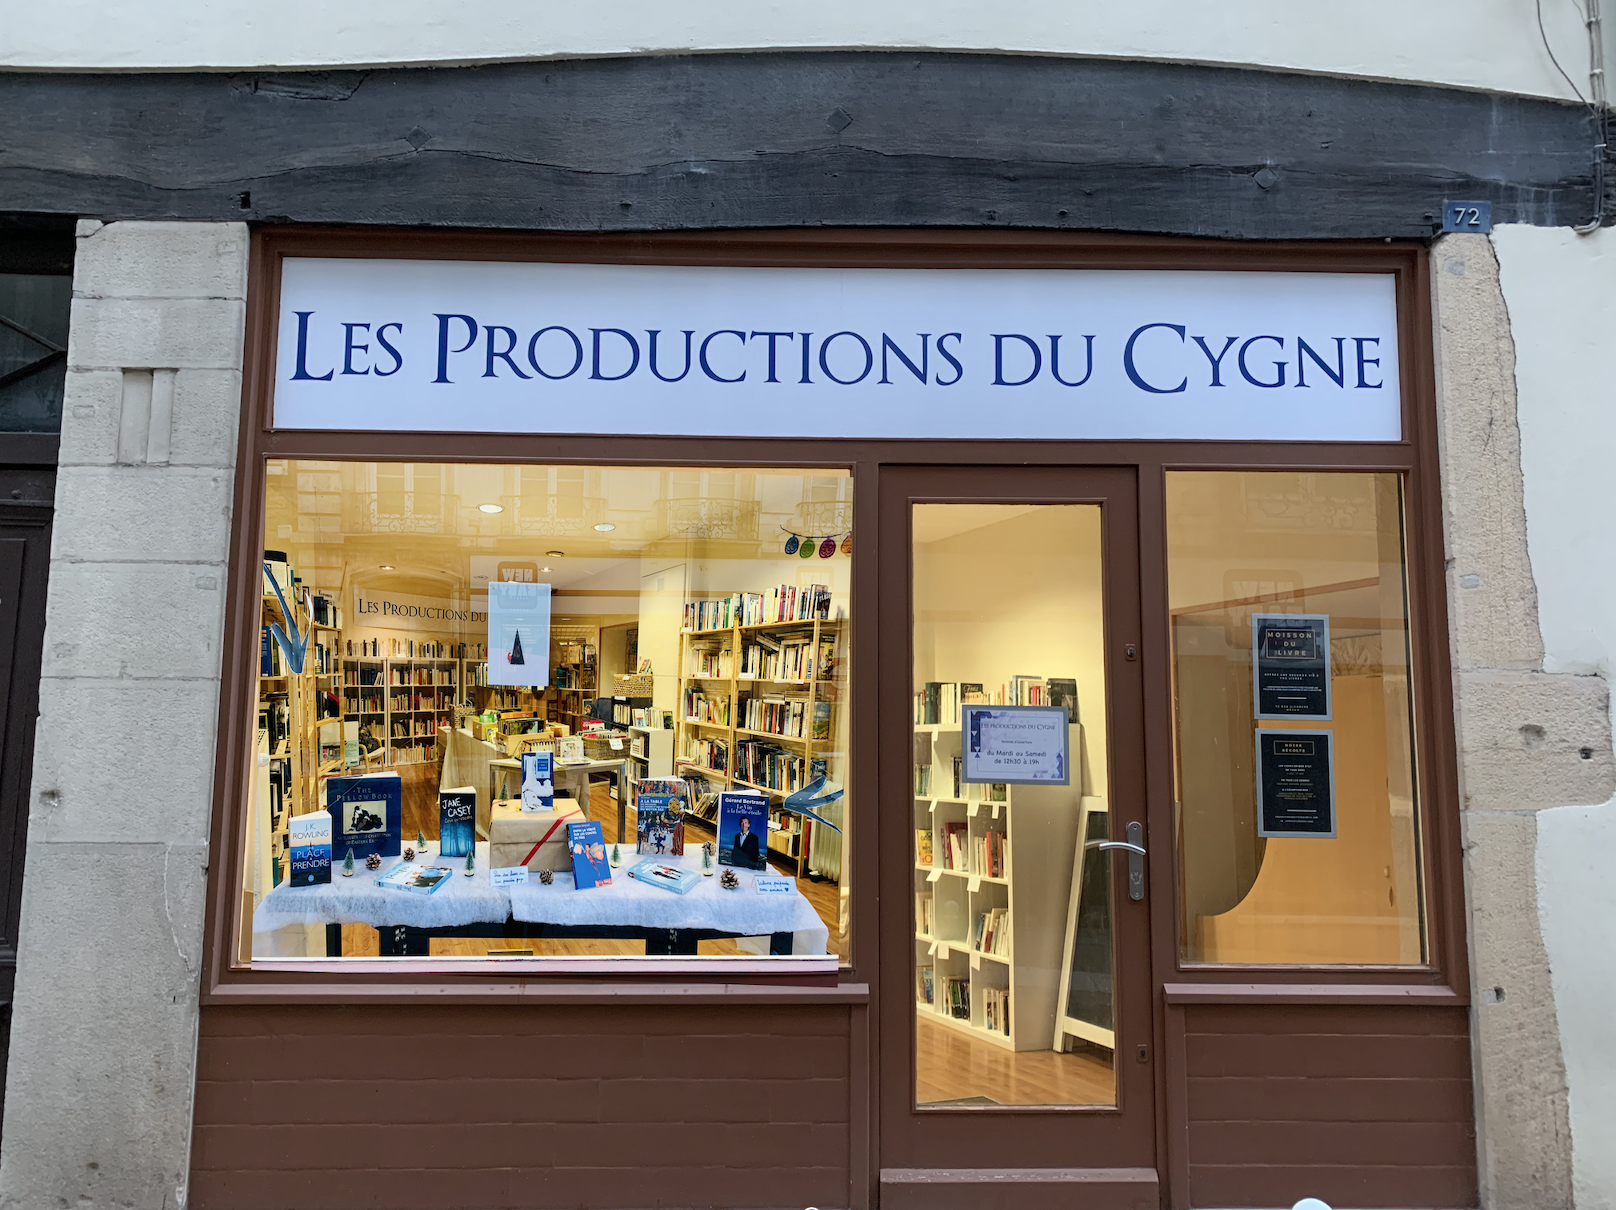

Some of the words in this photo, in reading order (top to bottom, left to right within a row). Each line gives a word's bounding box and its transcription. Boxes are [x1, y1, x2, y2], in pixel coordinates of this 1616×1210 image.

[1454, 207, 1480, 225] 72
[289, 310, 403, 382] LES
[430, 312, 964, 386] PRODUCTIONS
[989, 333, 1097, 387] DU
[1123, 322, 1384, 394] CYGNE
[358, 598, 379, 614] LES
[383, 600, 468, 622] PRODUCTIONS
[471, 611, 487, 623] DU
[1267, 631, 1312, 639] MOISSON
[336, 793, 369, 801] PILLOW
[442, 796, 461, 809] JANE
[447, 804, 472, 818] CASEY
[305, 822, 316, 830] J.K.
[292, 830, 329, 840] ROWLING
[296, 848, 325, 859] PLACE
[292, 858, 330, 870] PRENDRE
